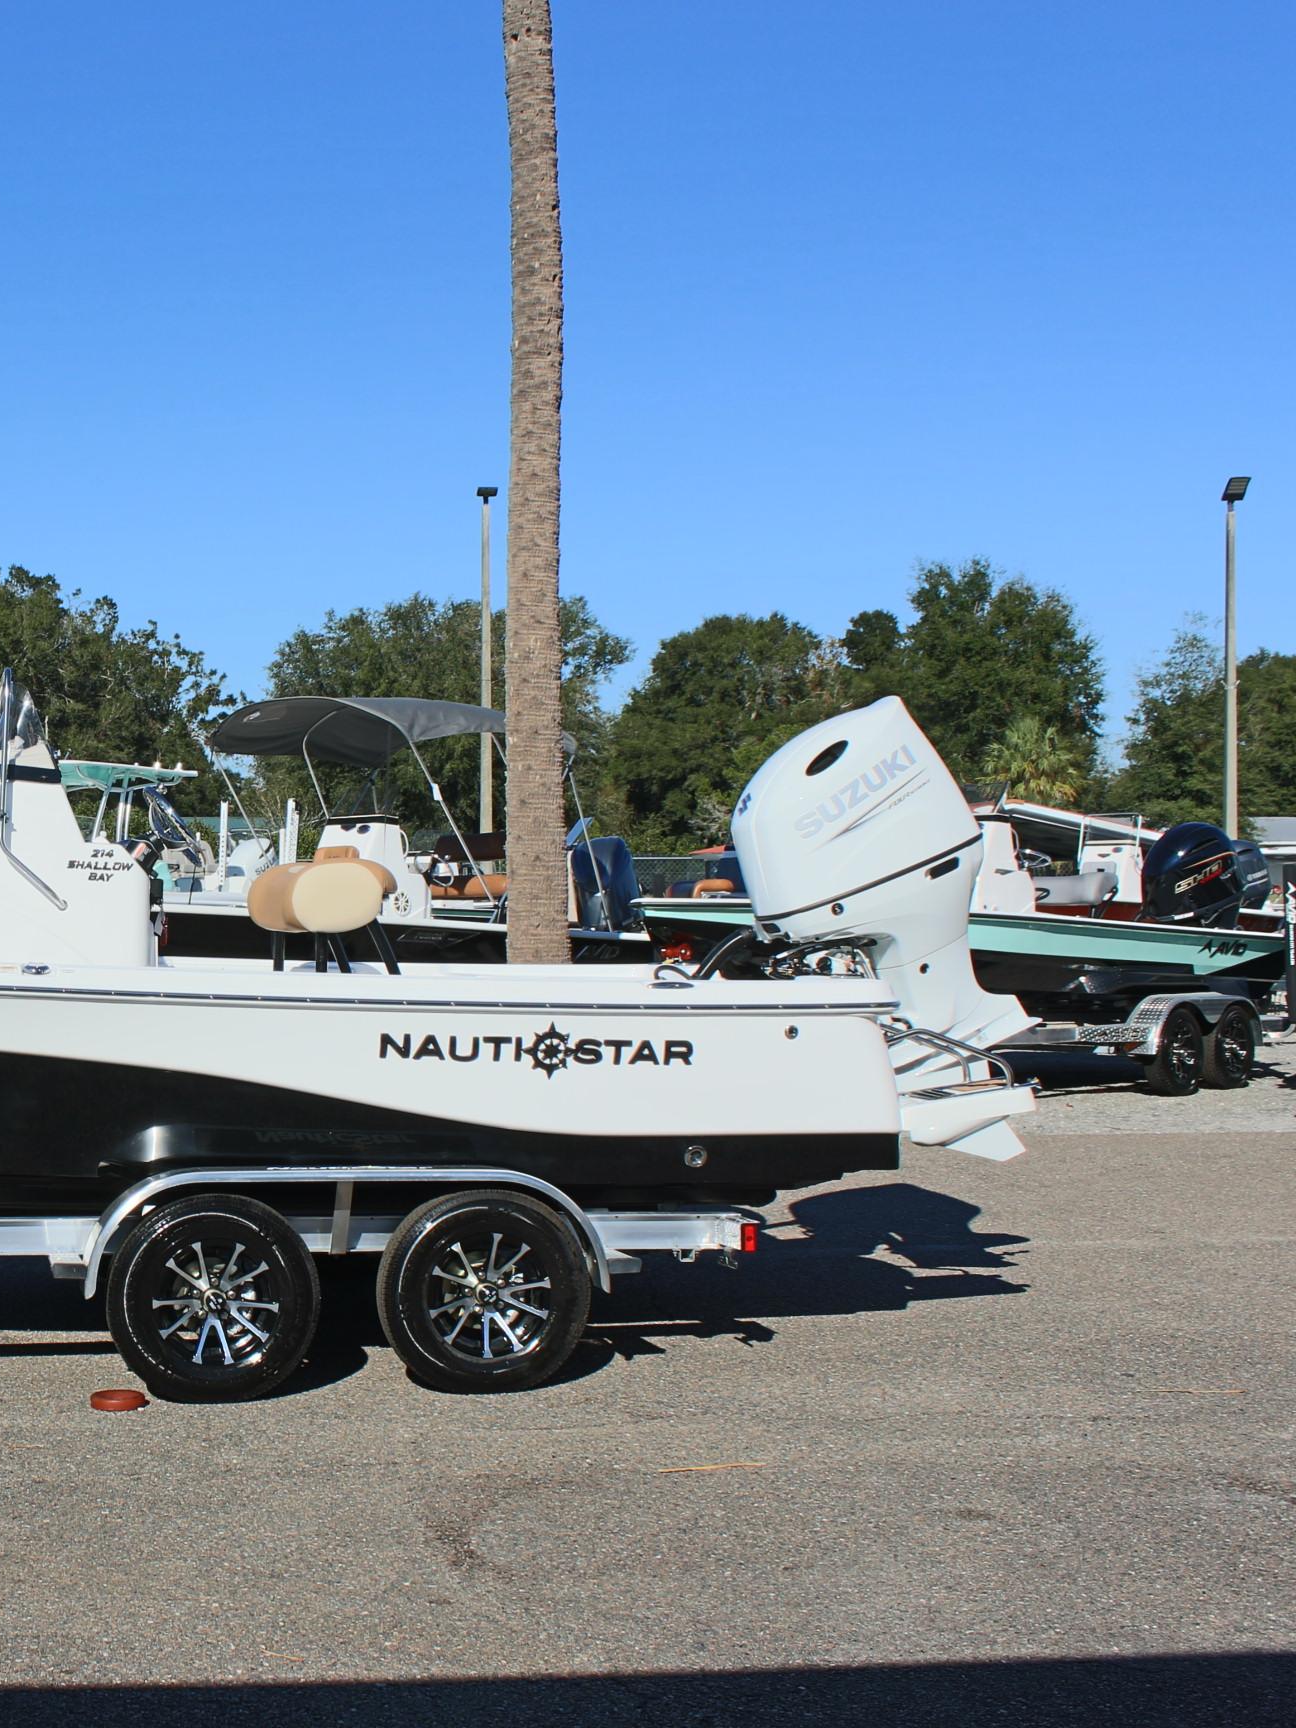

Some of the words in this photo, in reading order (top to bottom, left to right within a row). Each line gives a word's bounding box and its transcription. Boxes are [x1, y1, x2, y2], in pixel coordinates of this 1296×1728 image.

[795, 745, 916, 838] SUZUKI
[91, 849, 114, 858] 214
[67, 860, 133, 871] SHALLOW
[88, 872, 114, 881] BAY
[1209, 940, 1248, 958] AVID
